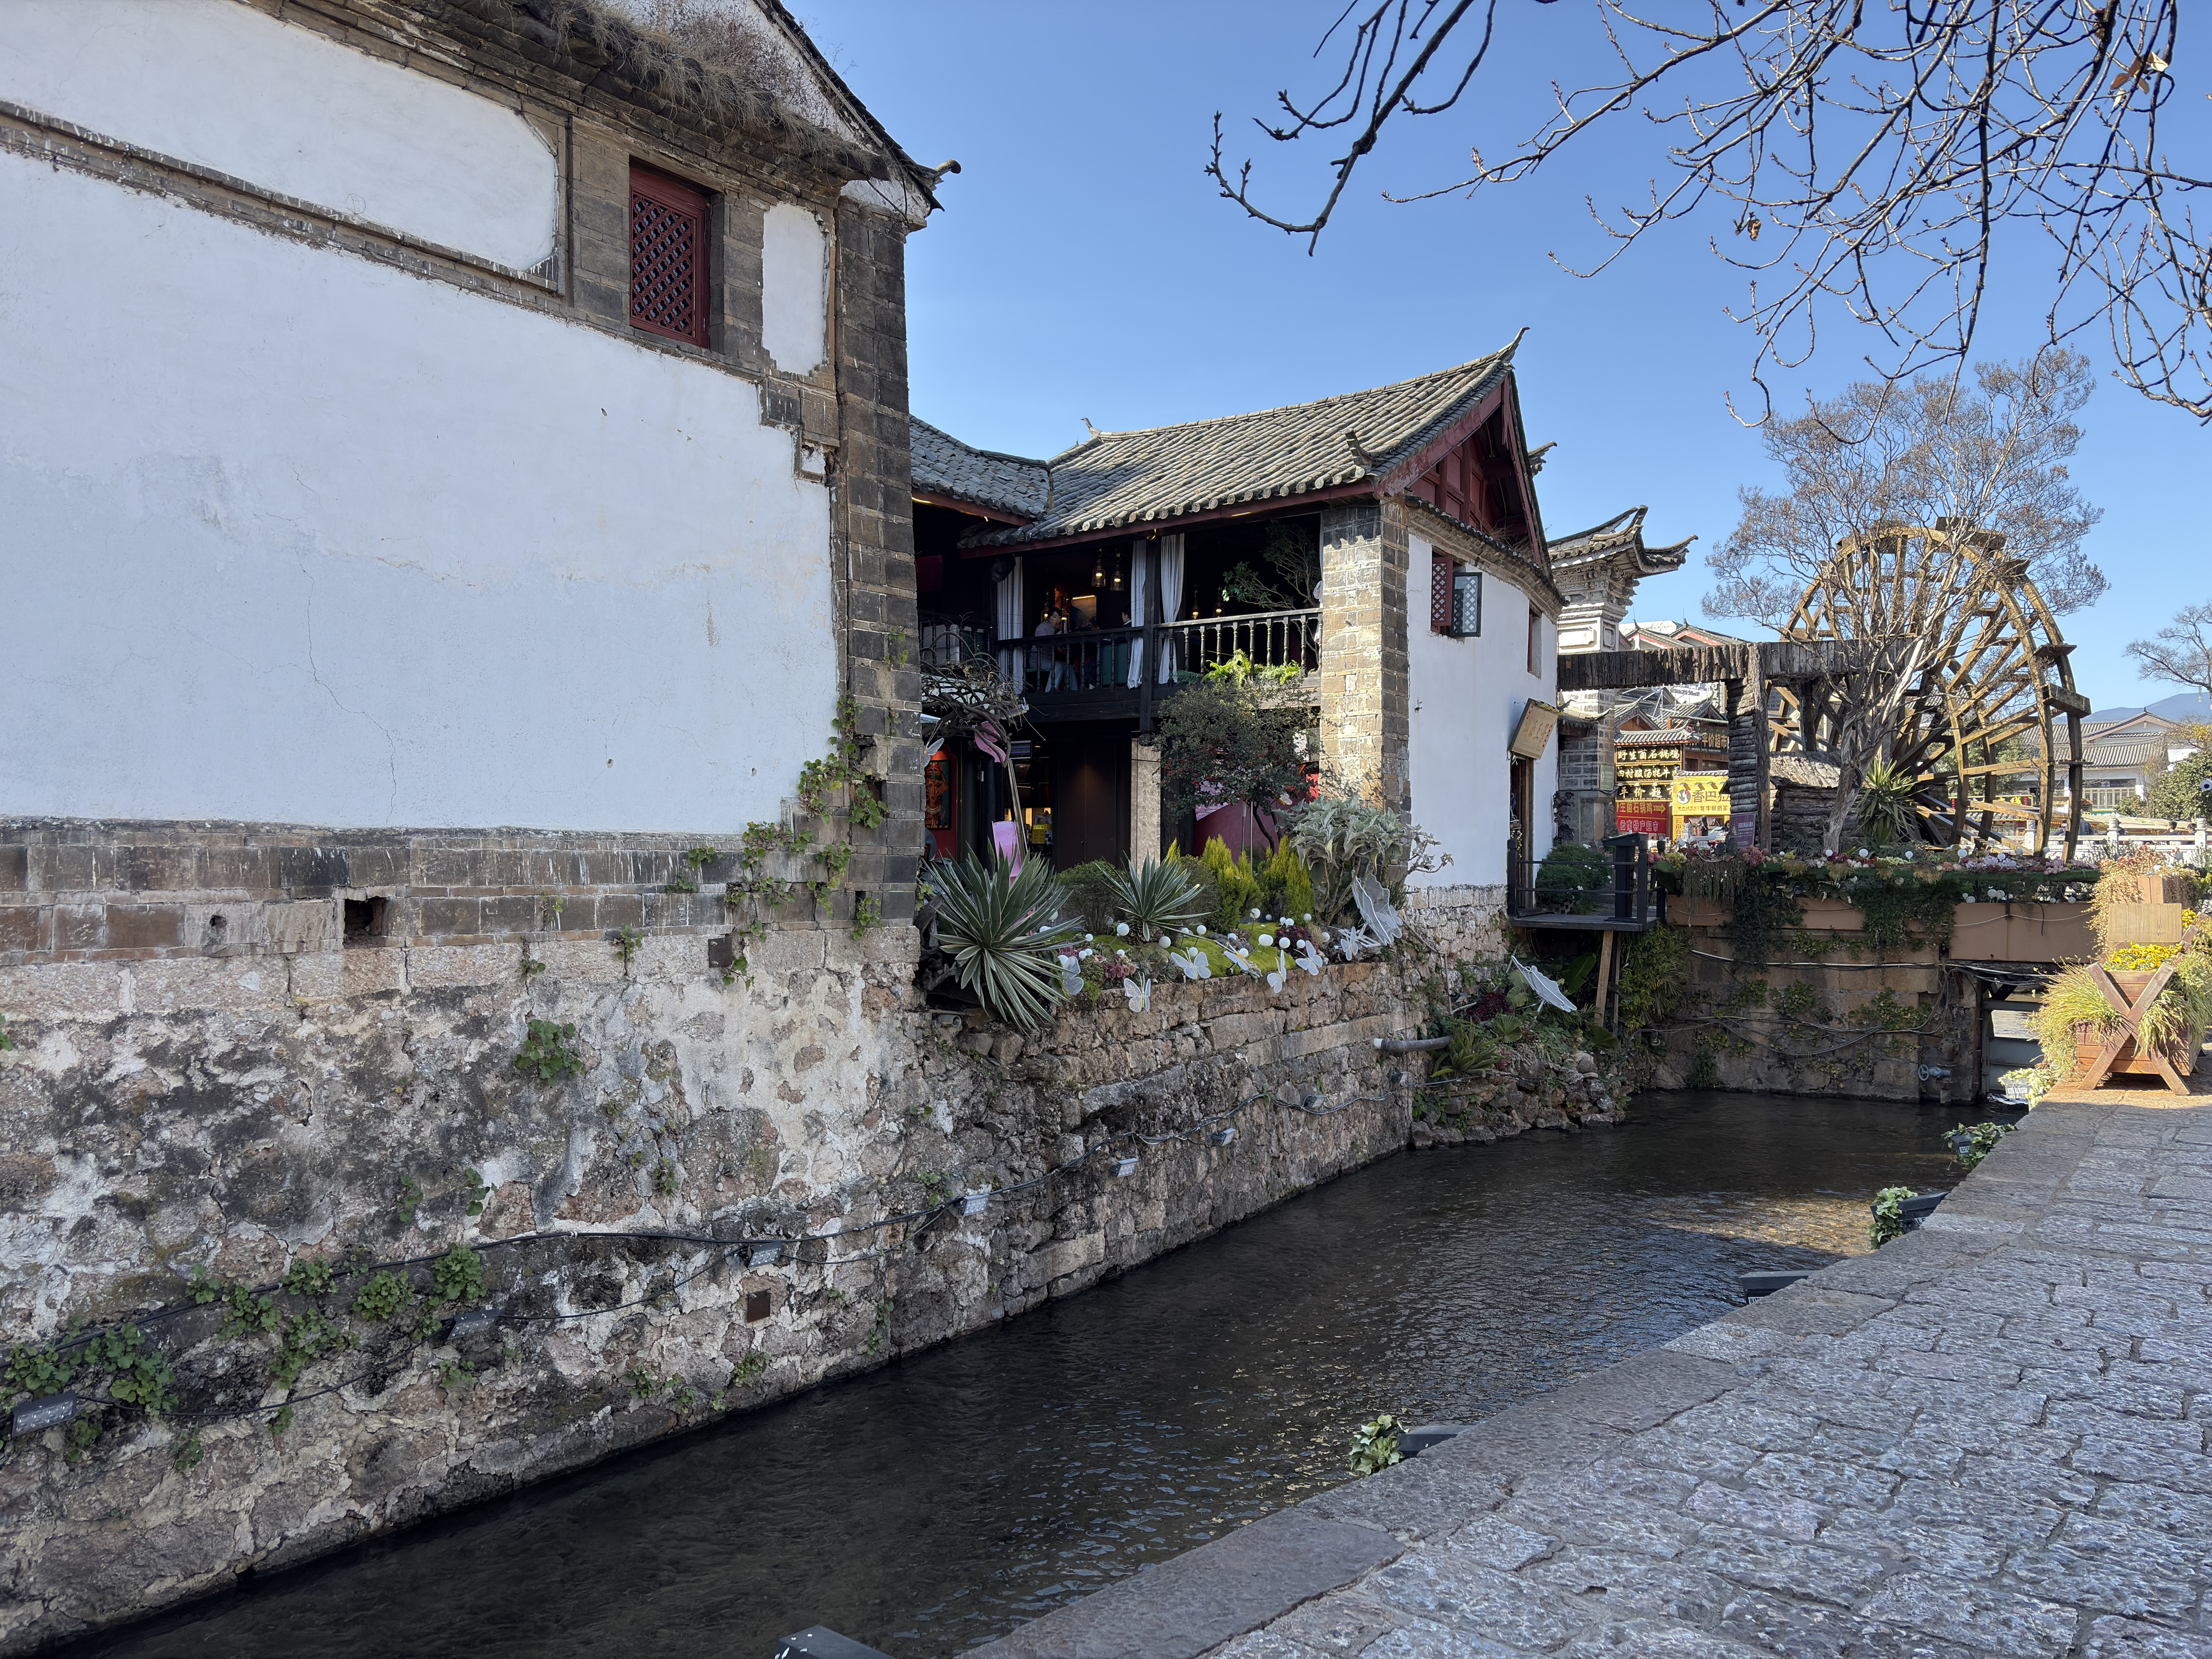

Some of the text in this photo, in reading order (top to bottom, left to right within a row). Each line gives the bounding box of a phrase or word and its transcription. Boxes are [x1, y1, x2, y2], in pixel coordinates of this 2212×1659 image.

[1702, 733, 1727, 749] 平价超市
[1620, 820, 1658, 832] 云南特产超市
